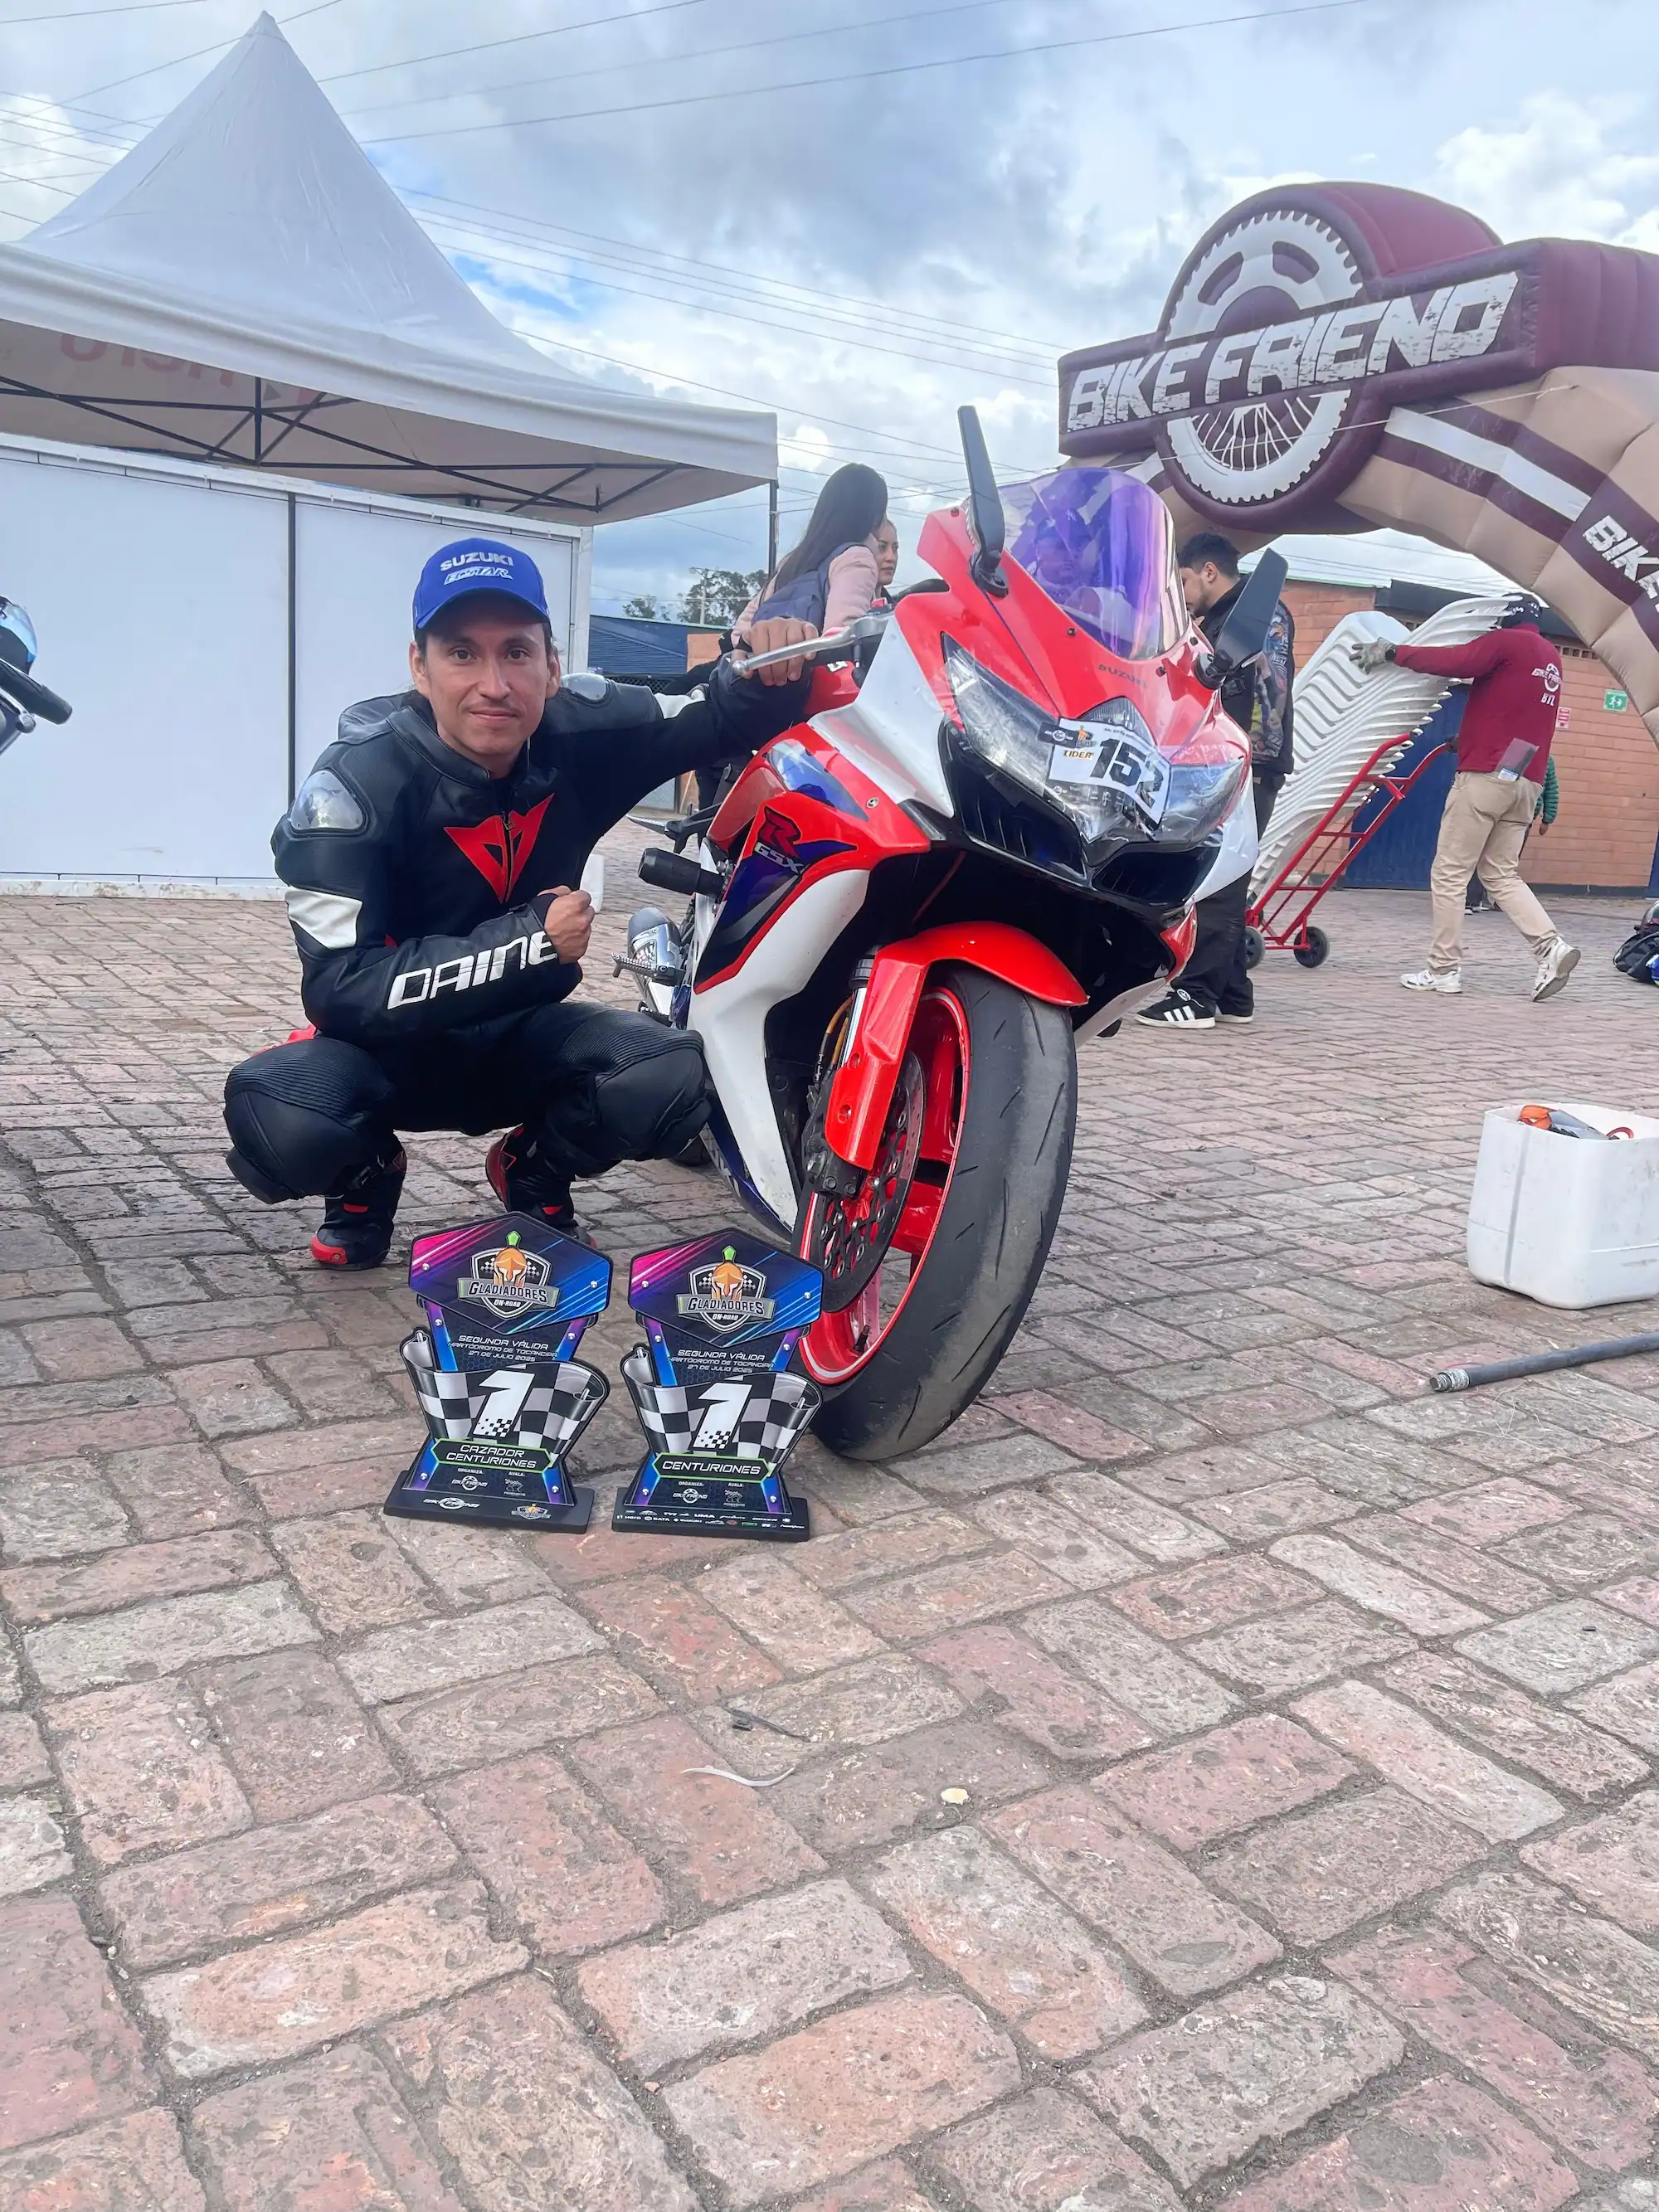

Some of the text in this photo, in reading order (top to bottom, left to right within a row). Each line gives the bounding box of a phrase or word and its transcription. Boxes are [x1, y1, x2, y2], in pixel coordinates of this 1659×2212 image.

[1066, 271, 1519, 432] BIKE FRIEND
[440, 552, 514, 571] SUZUKI
[444, 566, 513, 586] ECSTAR
[1098, 664, 1148, 688] SUZUKI
[1541, 693, 1555, 706] BTL
[759, 808, 800, 858] R
[754, 842, 810, 874] GSX
[469, 1281, 547, 1304] GLADIADORES
[688, 1298, 764, 1315] GLADIADORES
[459, 1335, 548, 1350] SEGUNDA VÁLIDA
[677, 1349, 766, 1361] SEGUNDA VÁLIDA
[473, 1370, 535, 1437] 1
[693, 1383, 752, 1449] 1
[446, 1452, 538, 1469] CENTURIONES
[460, 1444, 524, 1458] CAZADOR
[662, 1461, 761, 1475] CENTURIONES
